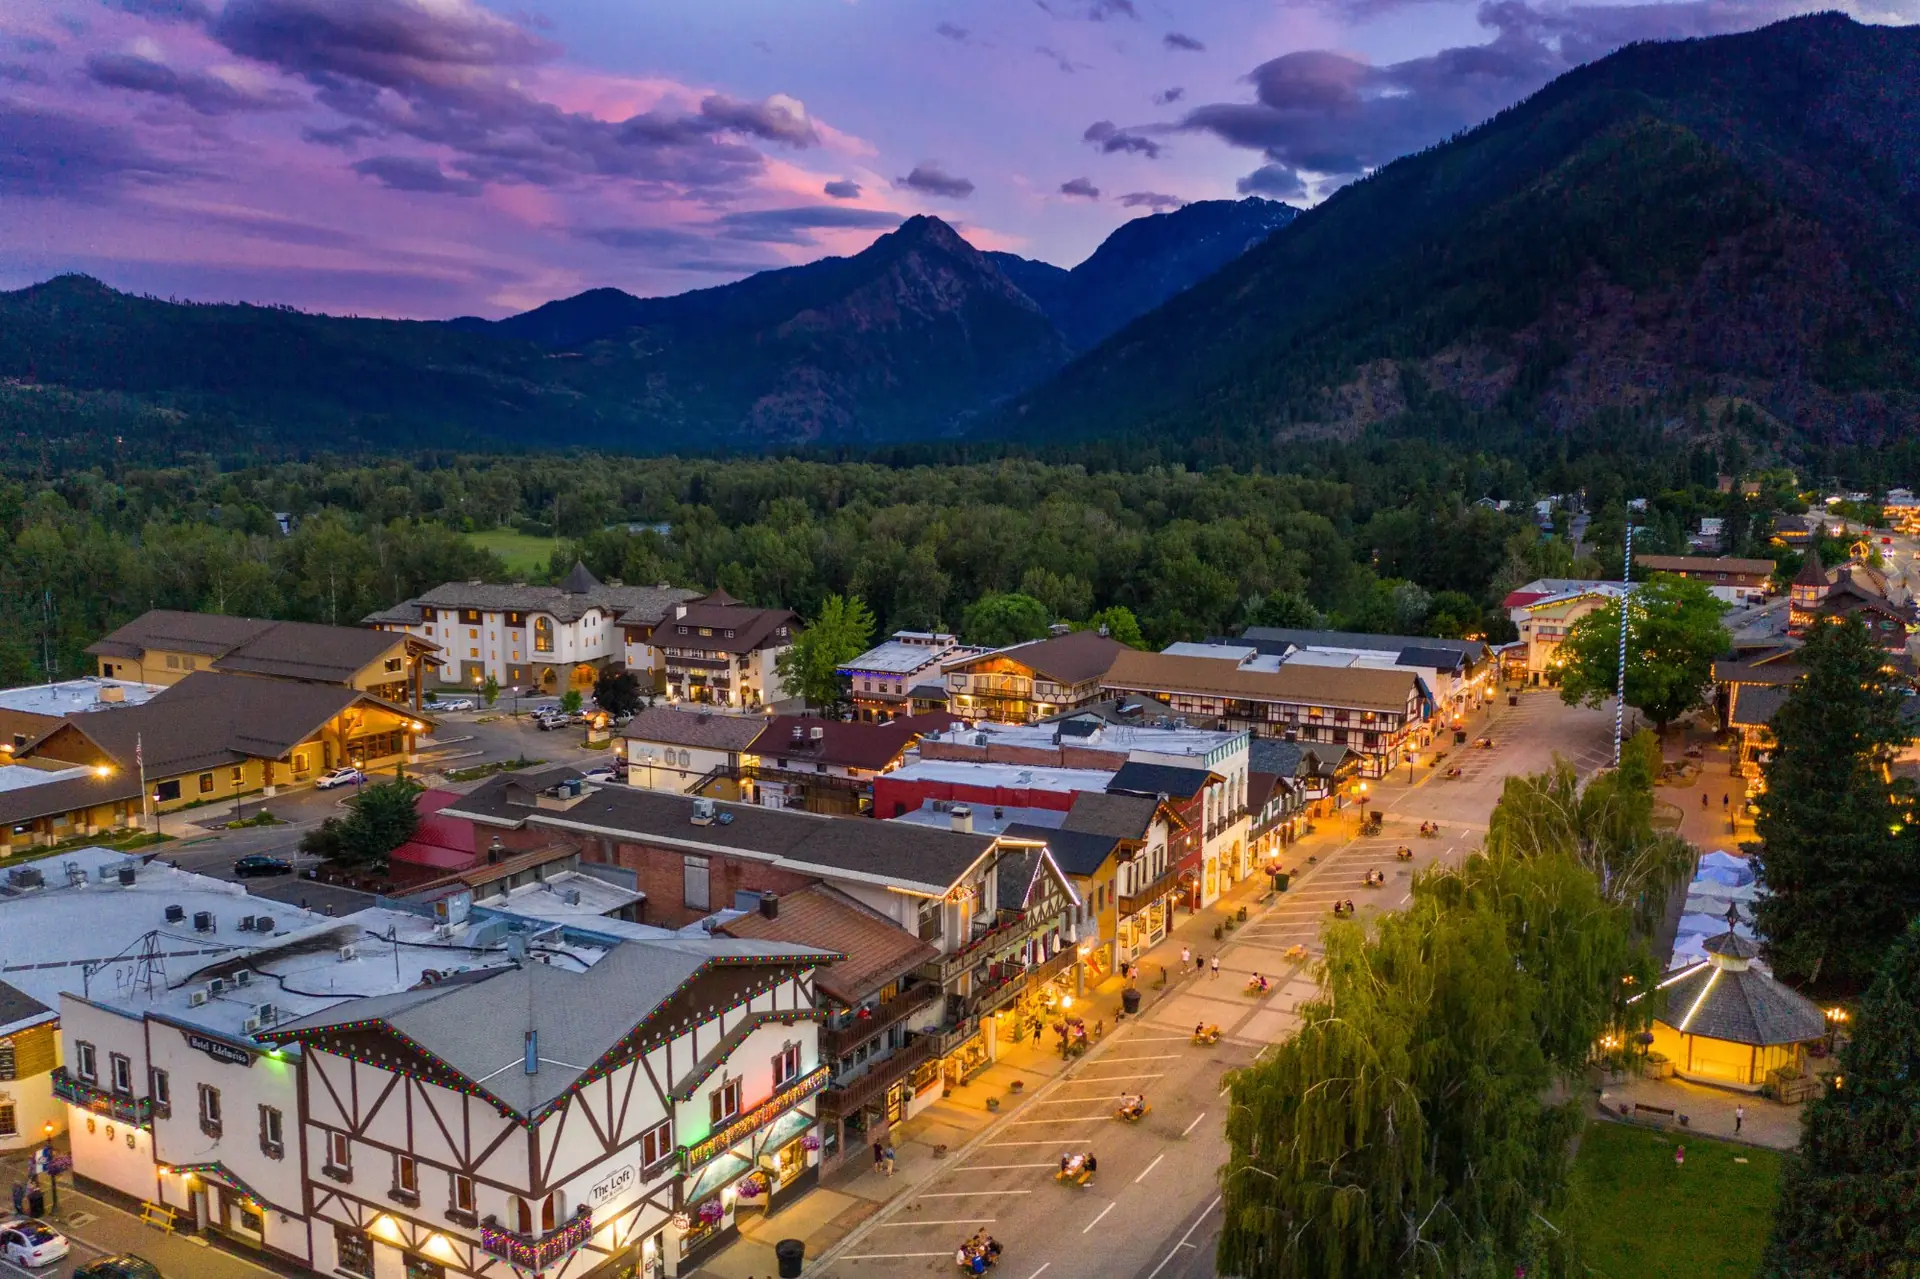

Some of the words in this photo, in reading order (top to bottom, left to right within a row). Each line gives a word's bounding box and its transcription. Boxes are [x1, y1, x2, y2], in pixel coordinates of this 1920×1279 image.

[191, 1037, 209, 1050] Hotel
[593, 1184, 608, 1199] The
[611, 1170, 630, 1189] Loft
